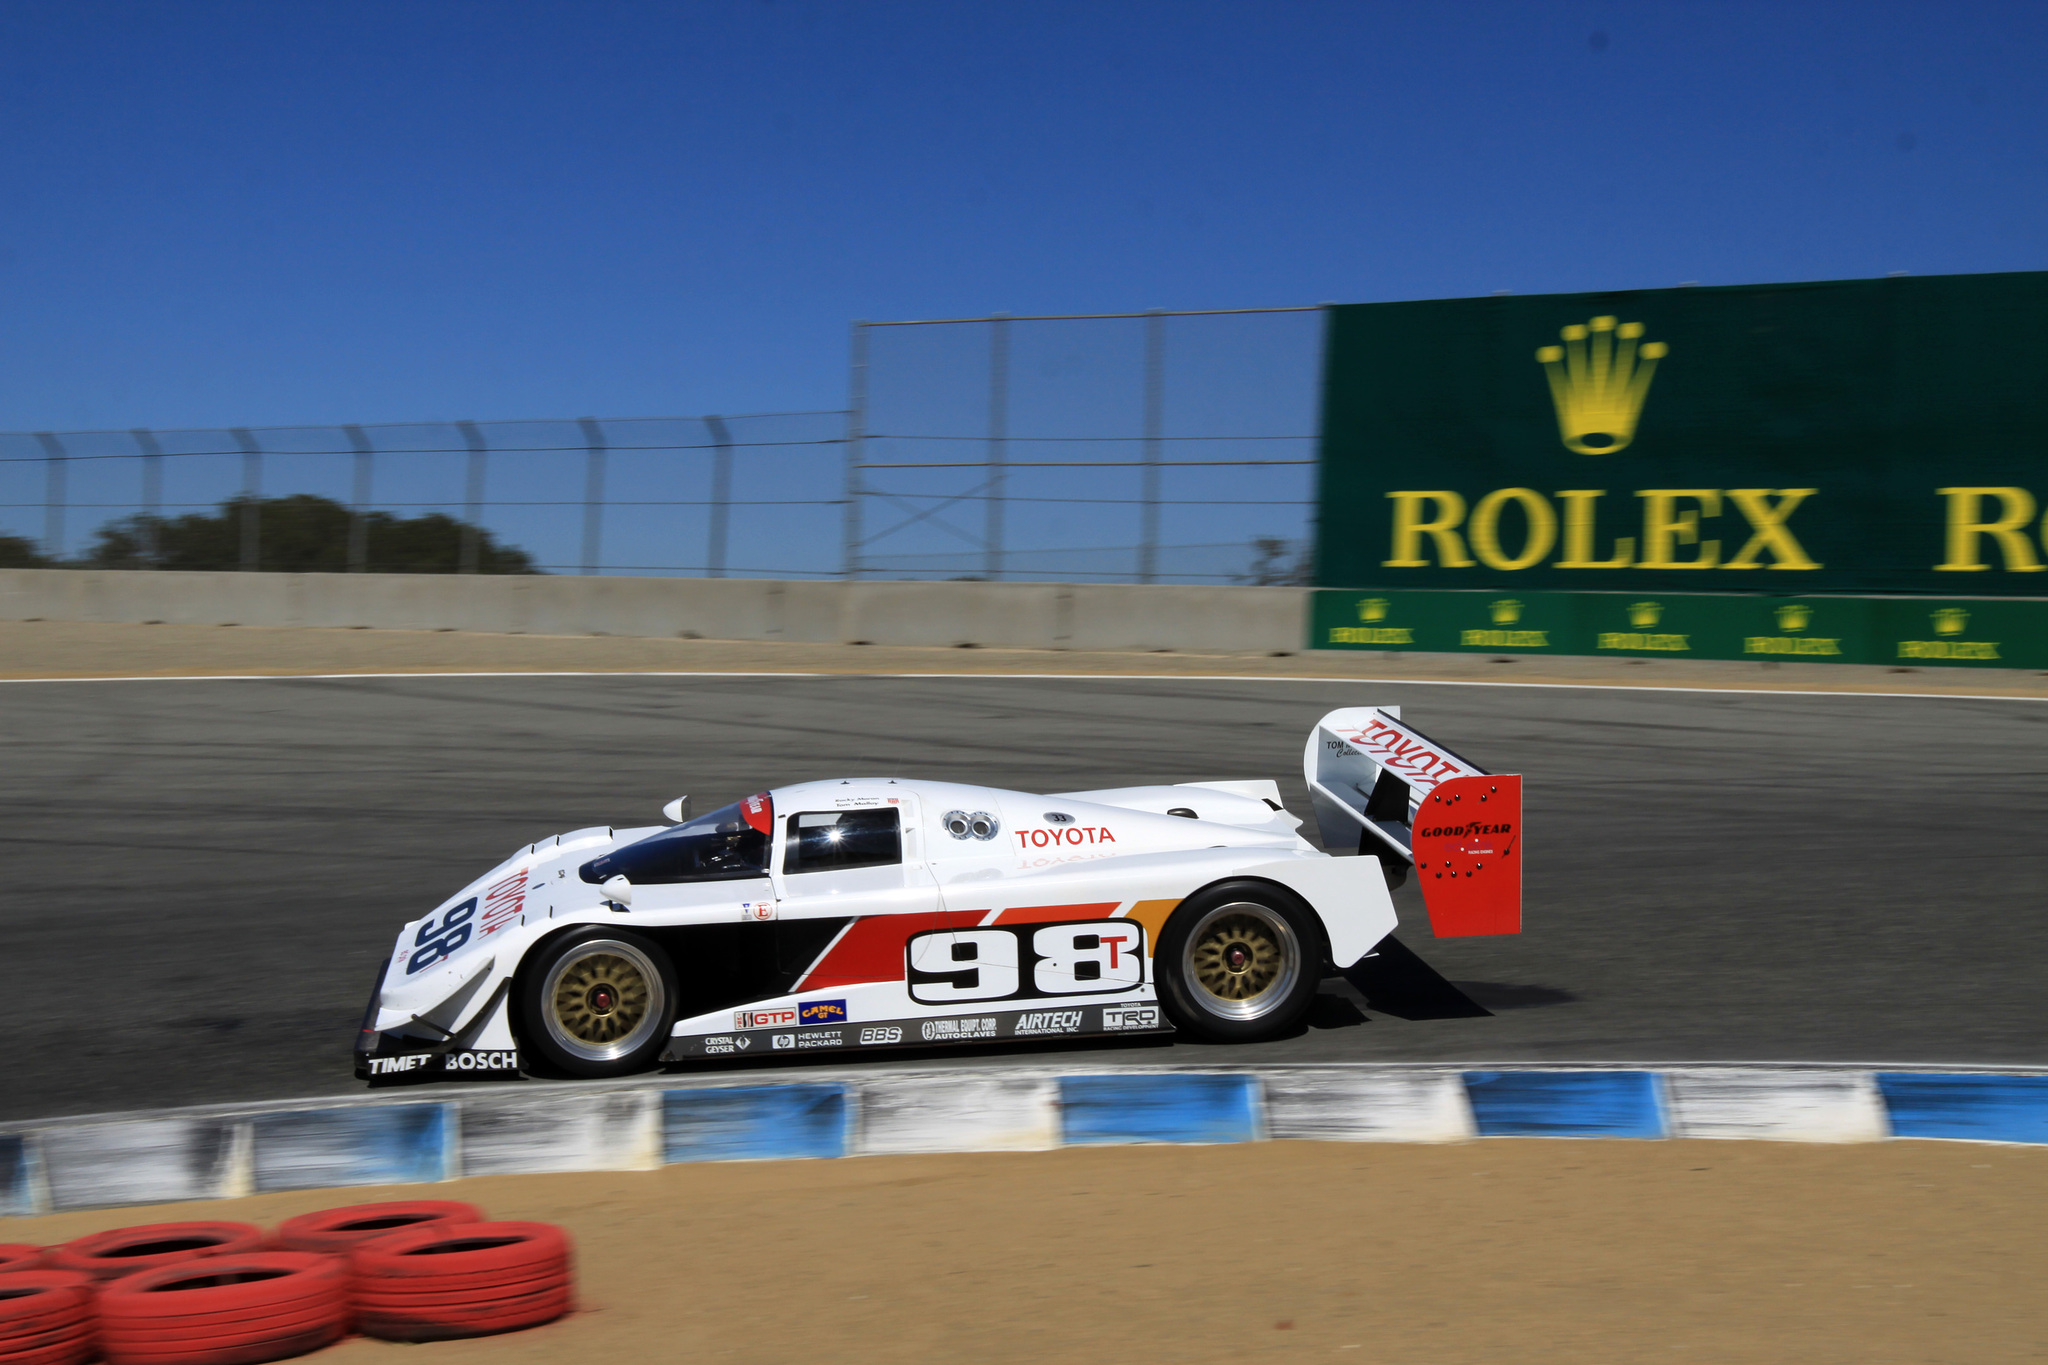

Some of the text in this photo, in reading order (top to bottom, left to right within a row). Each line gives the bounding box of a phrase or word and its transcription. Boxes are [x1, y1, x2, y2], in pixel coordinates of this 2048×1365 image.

[1380, 487, 1825, 571] ROLEX
[1931, 486, 2048, 573] R
[1326, 741, 1344, 750] TOM
[1051, 813, 1067, 823] 33
[1421, 822, 1512, 838] GOODYEAR
[1015, 827, 1116, 849] TOYOTA
[477, 866, 529, 941] TOYOTA
[405, 896, 479, 975] 98
[908, 920, 1142, 1003] 98
[753, 1011, 795, 1025] GTP
[801, 1004, 844, 1018] CAMEL
[817, 1011, 829, 1019] GT
[1105, 1008, 1157, 1025] TRD
[935, 1020, 960, 1034] THERMAL
[1015, 1010, 1083, 1030] AIRTECH
[798, 1031, 843, 1040] HEWLETT
[859, 1026, 903, 1045] BBS
[934, 1030, 997, 1040] AUTOCLAVES
[1014, 1027, 1064, 1036] INTERNATIONAL
[705, 1036, 734, 1045] CRYSTAL
[798, 1039, 843, 1048] PACKARD
[705, 1045, 735, 1054] GEYSER
[368, 1053, 432, 1075] TIMET
[445, 1052, 518, 1071] BOSCH
